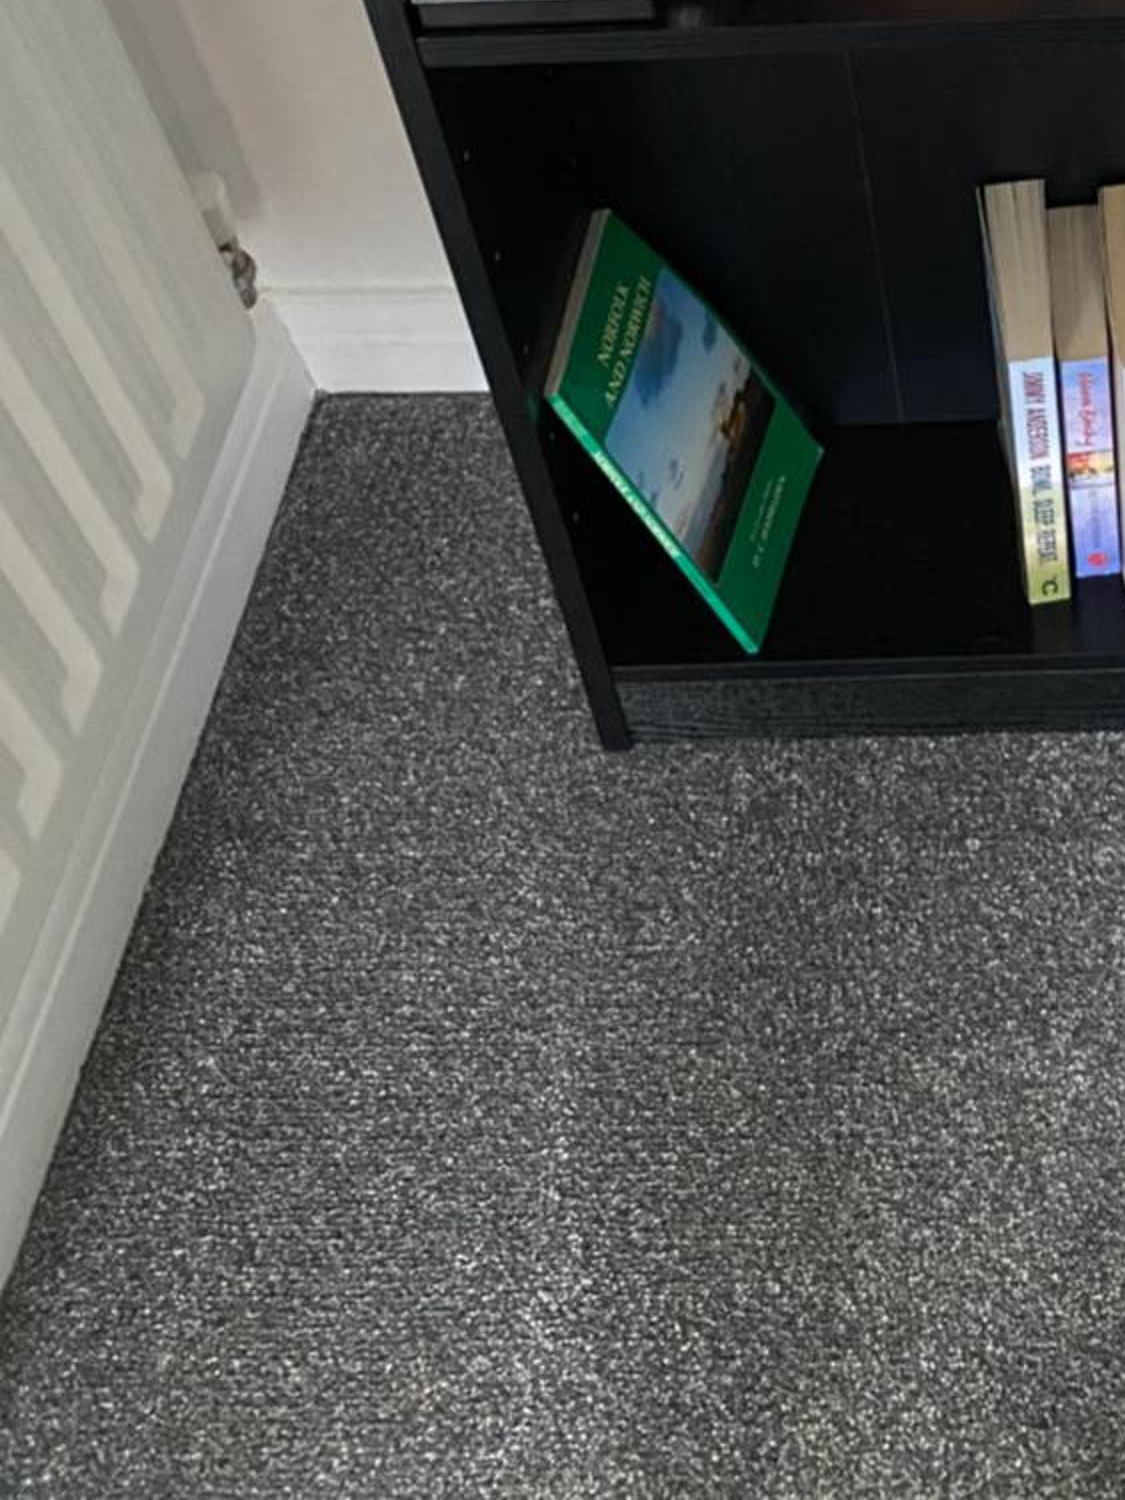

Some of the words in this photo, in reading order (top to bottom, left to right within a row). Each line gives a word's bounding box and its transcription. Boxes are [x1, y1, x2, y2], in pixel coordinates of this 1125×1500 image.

[597, 284, 630, 369] NORFOLK
[604, 359, 627, 411] AND
[619, 274, 653, 357] NORWICH
